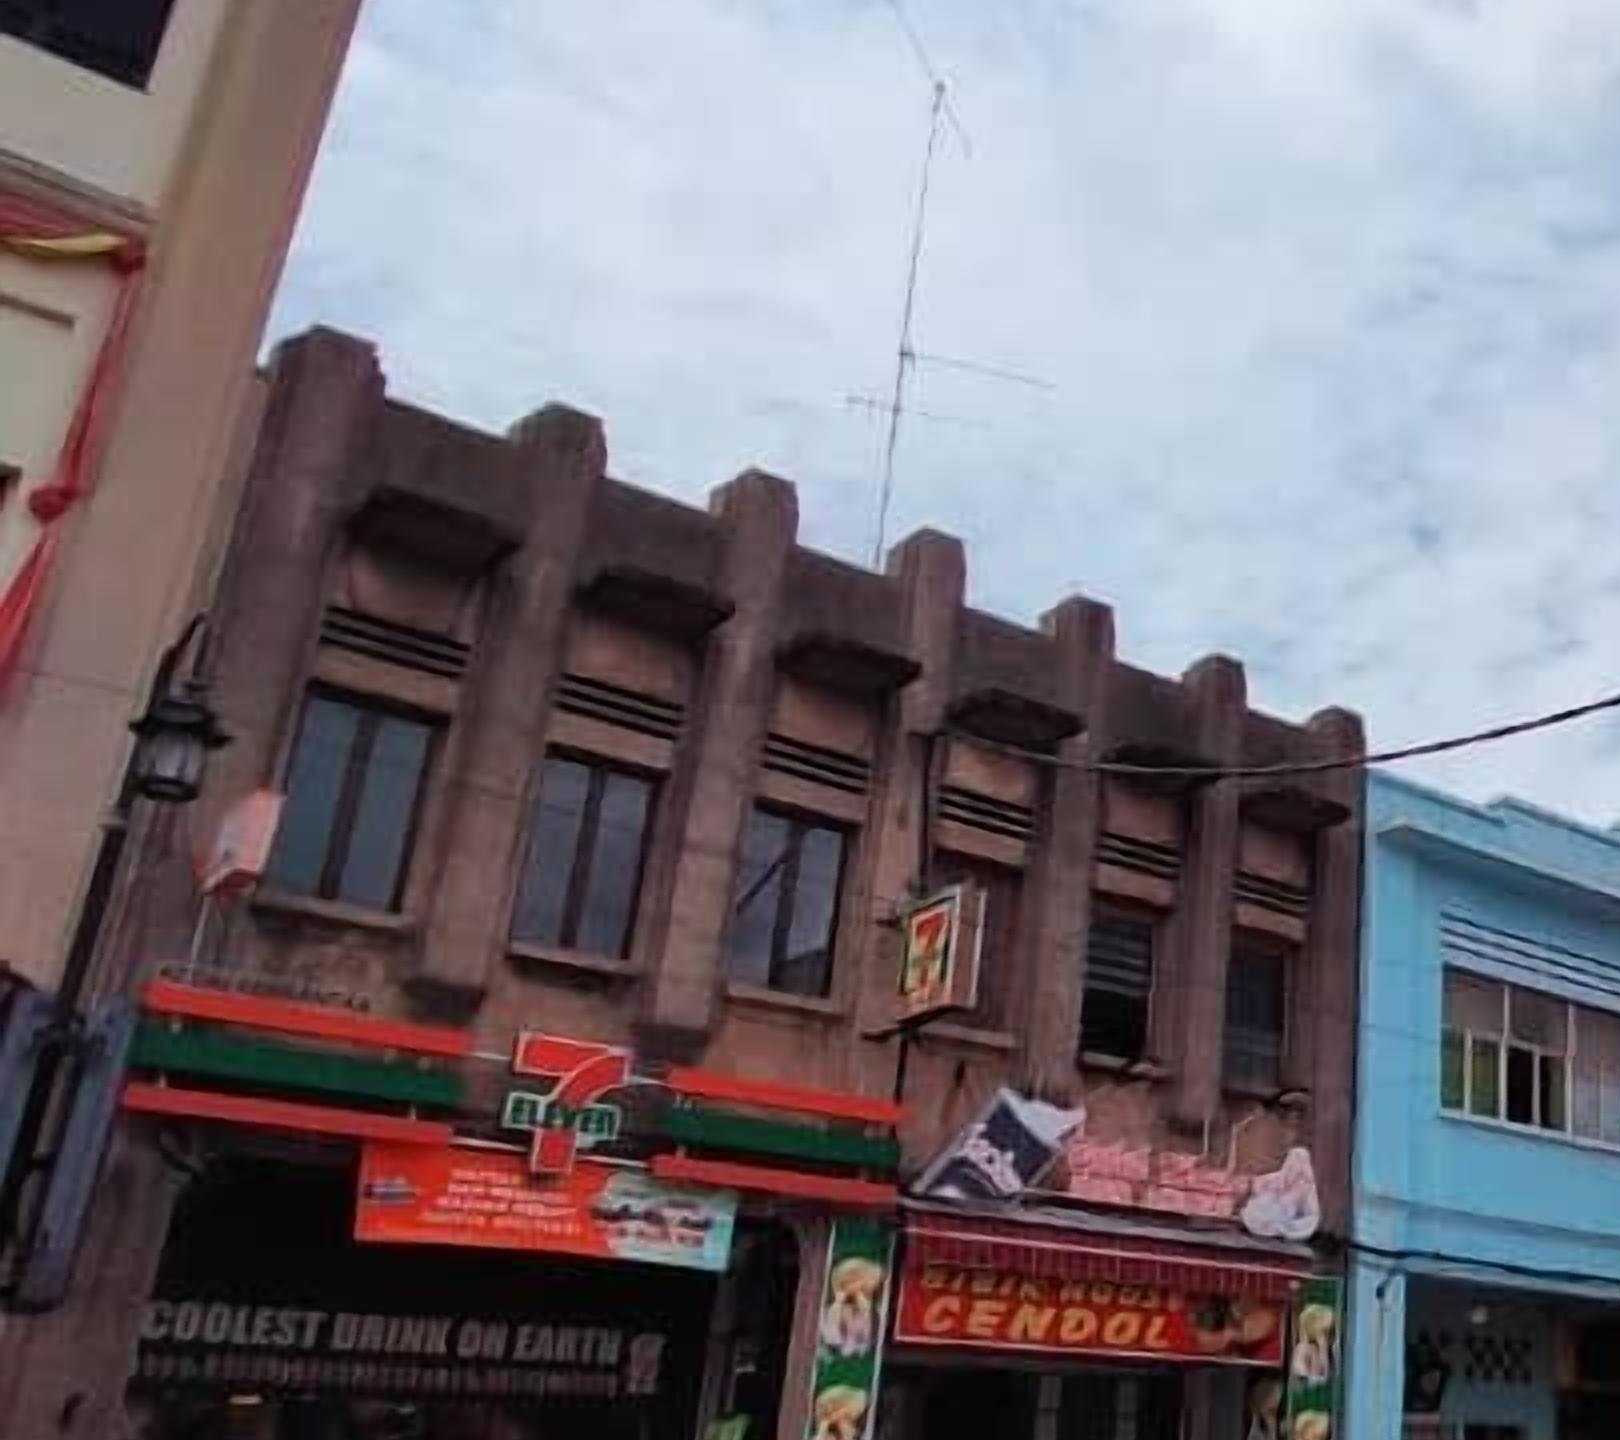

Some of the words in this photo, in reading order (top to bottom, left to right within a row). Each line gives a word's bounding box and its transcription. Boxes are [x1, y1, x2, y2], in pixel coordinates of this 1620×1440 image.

[515, 1031, 633, 1174] 7
[141, 1301, 328, 1349] COOLEST
[330, 1312, 452, 1354] DRINK
[457, 1320, 508, 1360] ON
[513, 1325, 622, 1365] EARTH
[921, 1296, 1171, 1349] CENDOL
